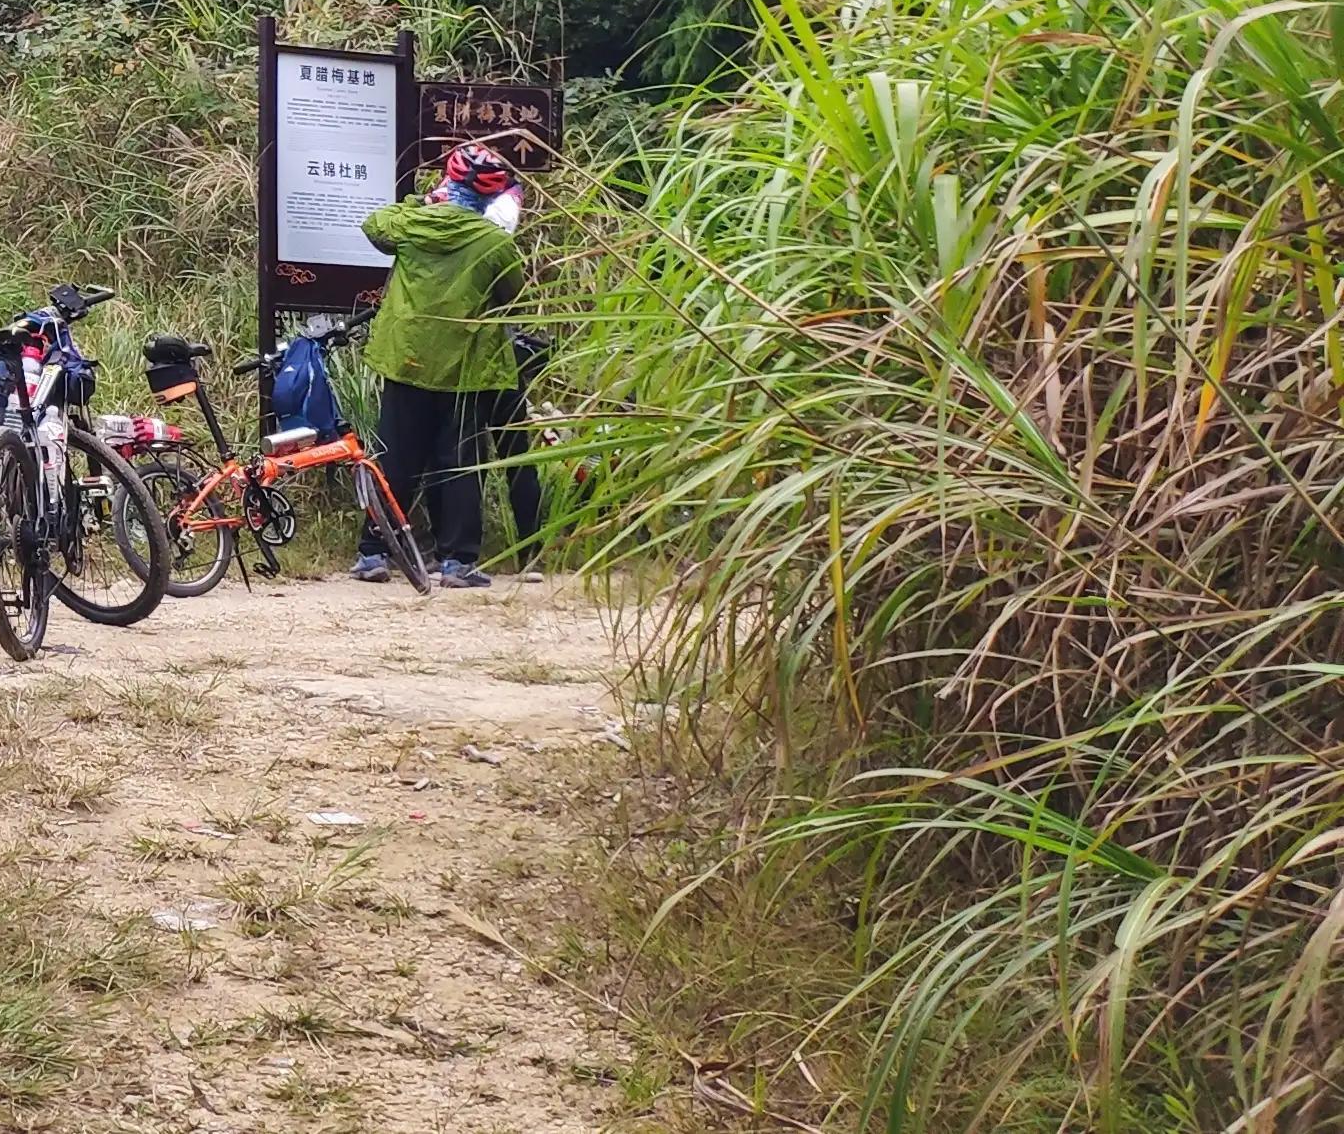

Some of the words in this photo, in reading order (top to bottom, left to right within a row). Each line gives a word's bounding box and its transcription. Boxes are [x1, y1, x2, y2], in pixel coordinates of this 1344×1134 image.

[299, 64, 376, 87] 夏腊梅基地
[307, 160, 368, 181] 云锦杜鹃
